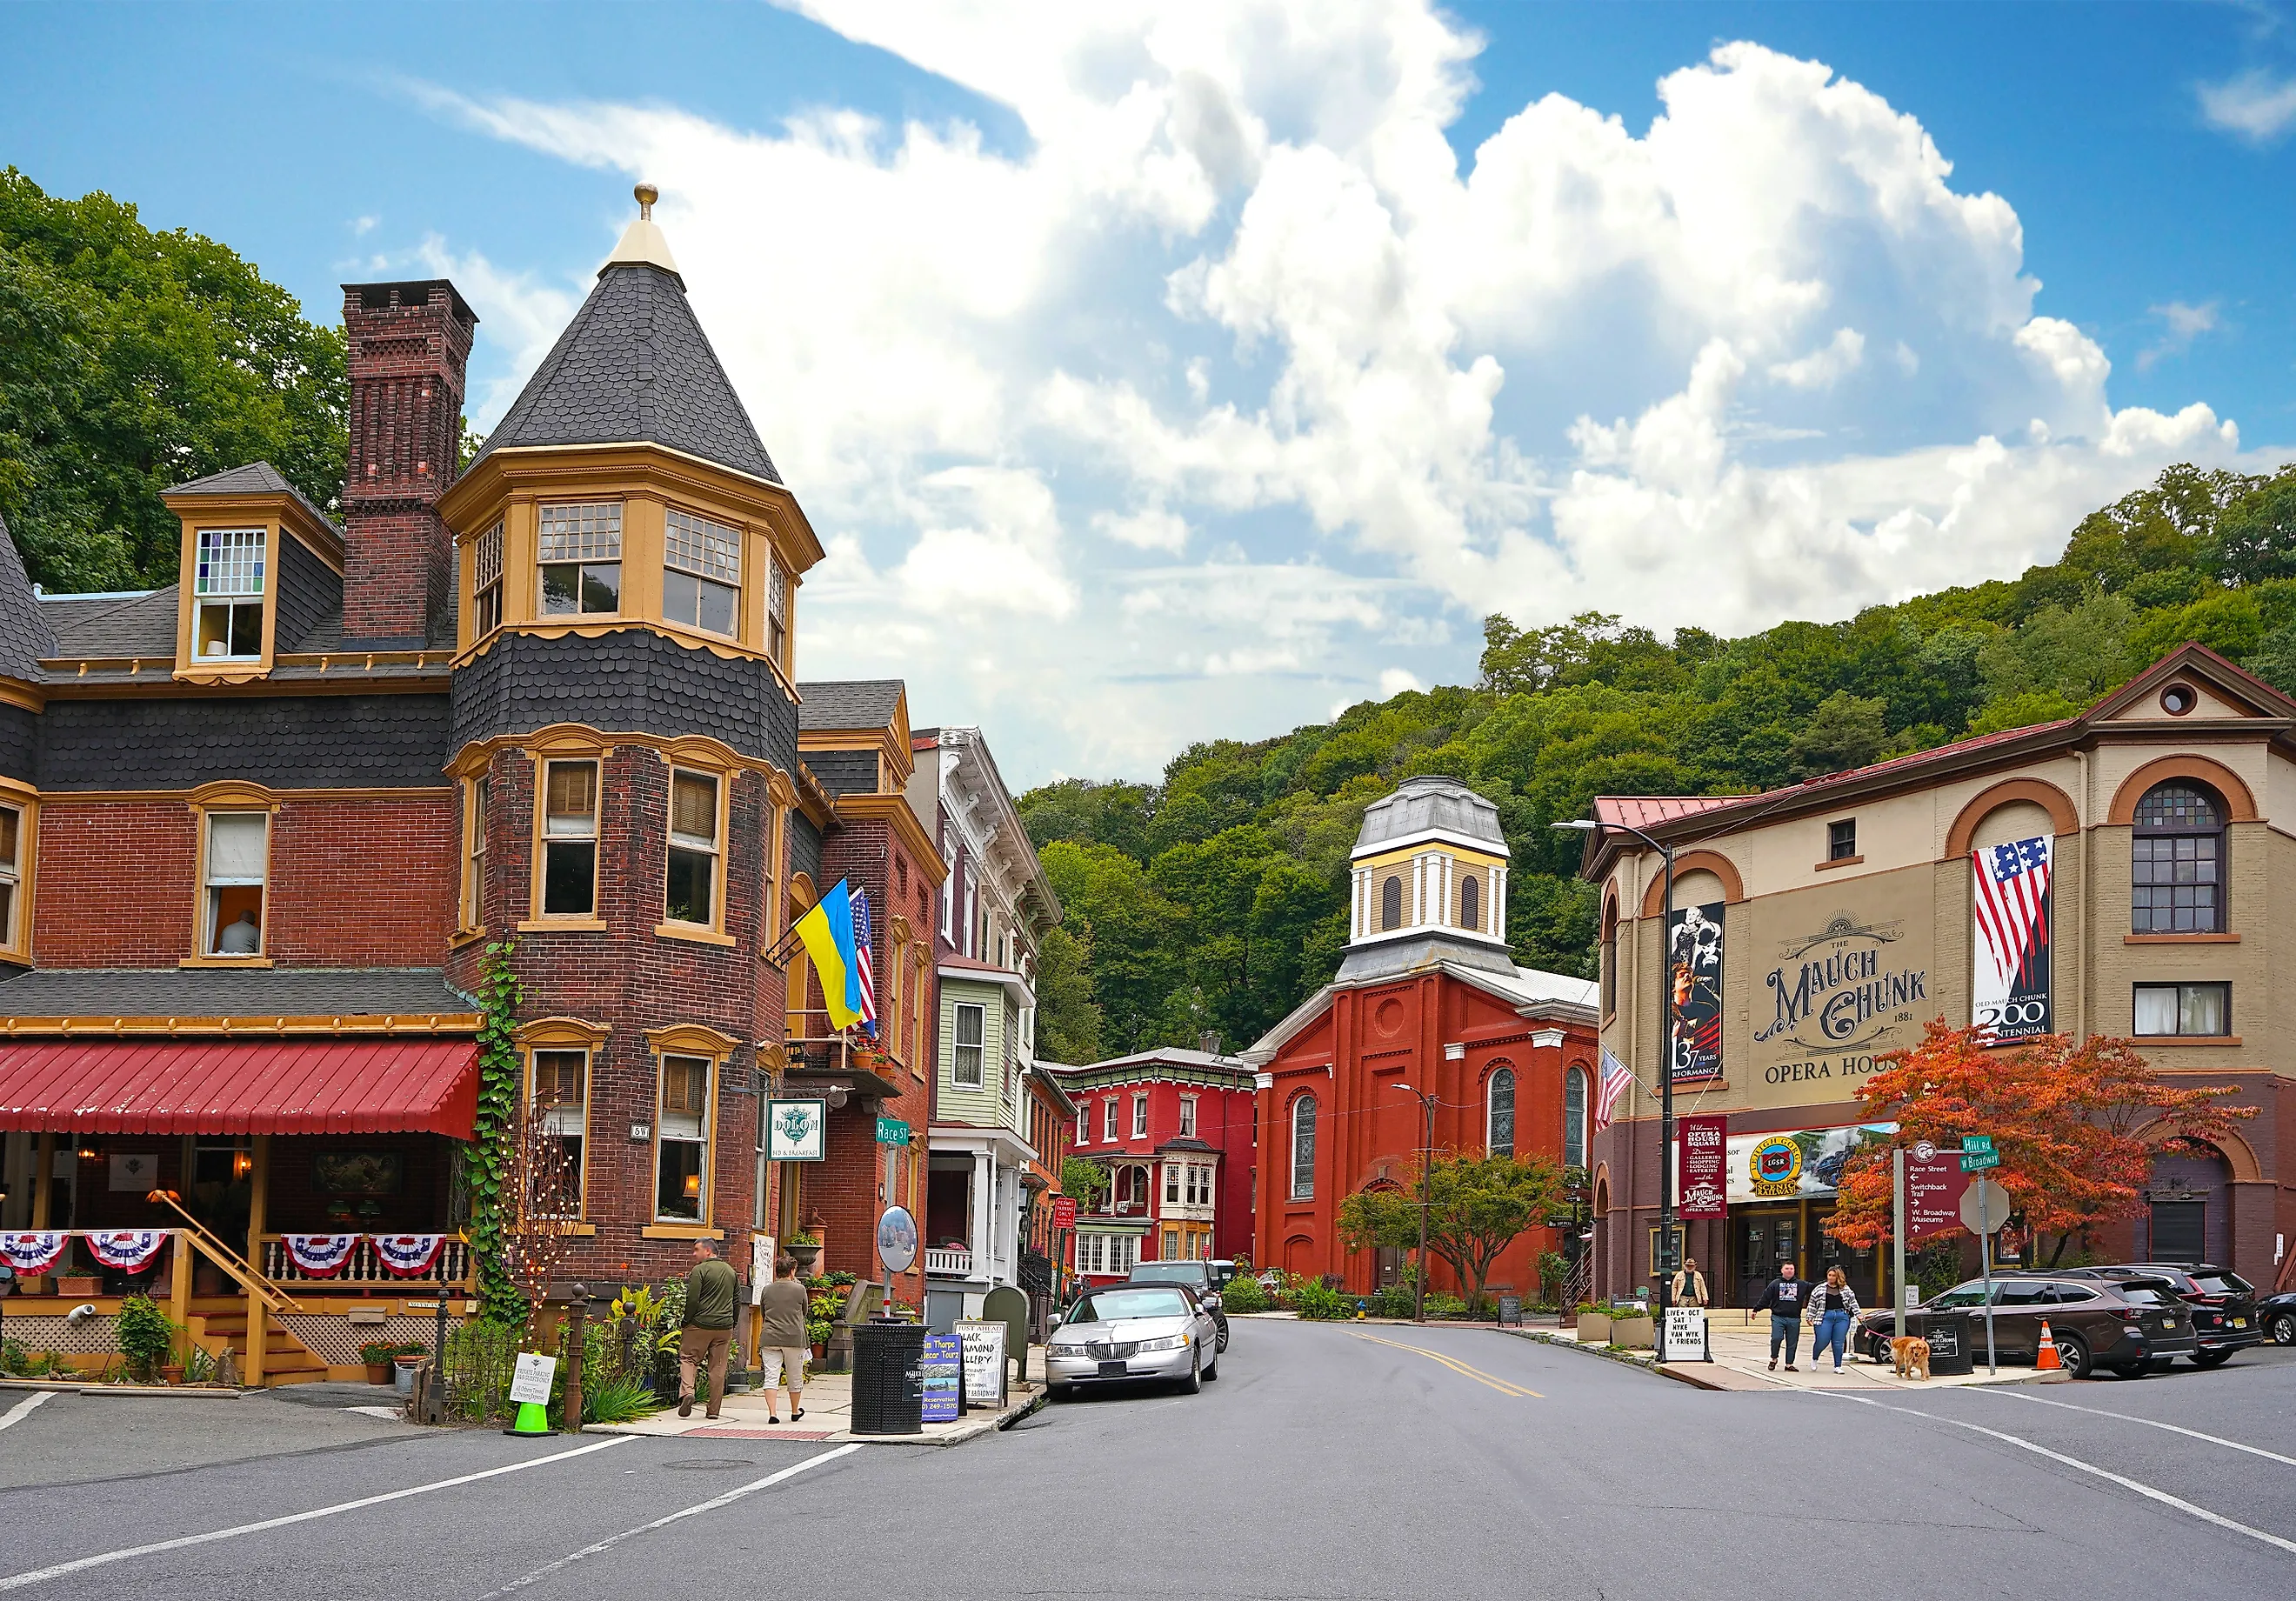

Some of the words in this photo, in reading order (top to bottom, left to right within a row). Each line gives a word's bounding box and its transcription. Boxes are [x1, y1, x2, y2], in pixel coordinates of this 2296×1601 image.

[1831, 940, 1848, 949] THE
[1754, 949, 1877, 1041] MAUCH
[1991, 997, 2018, 1006] MAUCH
[2019, 992, 2047, 1002] CHUNK
[1819, 969, 1927, 1040] CHUNK
[1894, 1012, 1912, 1022] 1881
[1979, 1001, 2046, 1028] 200
[1997, 1025, 2047, 1037] NTENNIAL
[1672, 1067, 1719, 1078] RFORMANCE
[1765, 1060, 1831, 1084] OPERA
[1842, 1055, 1899, 1077] HOUS
[773, 1119, 818, 1131] DOLON
[878, 1122, 898, 1140] Race
[899, 1127, 907, 1140] ST
[1965, 1139, 1979, 1151] Hill
[1982, 1141, 1991, 1150] Rd
[1752, 1138, 1777, 1171] LEHIGH
[1781, 1138, 1800, 1167] GORGE
[1962, 1160, 1967, 1169] W
[1968, 1156, 1998, 1168] Broadway
[1758, 1182, 1794, 1191] SCENIC
[1681, 1189, 1712, 1204] MAUCH
[1697, 1194, 1724, 1205] CHUNK
[934, 1339, 955, 1351] Thorpe
[941, 1350, 959, 1358] Tourz
